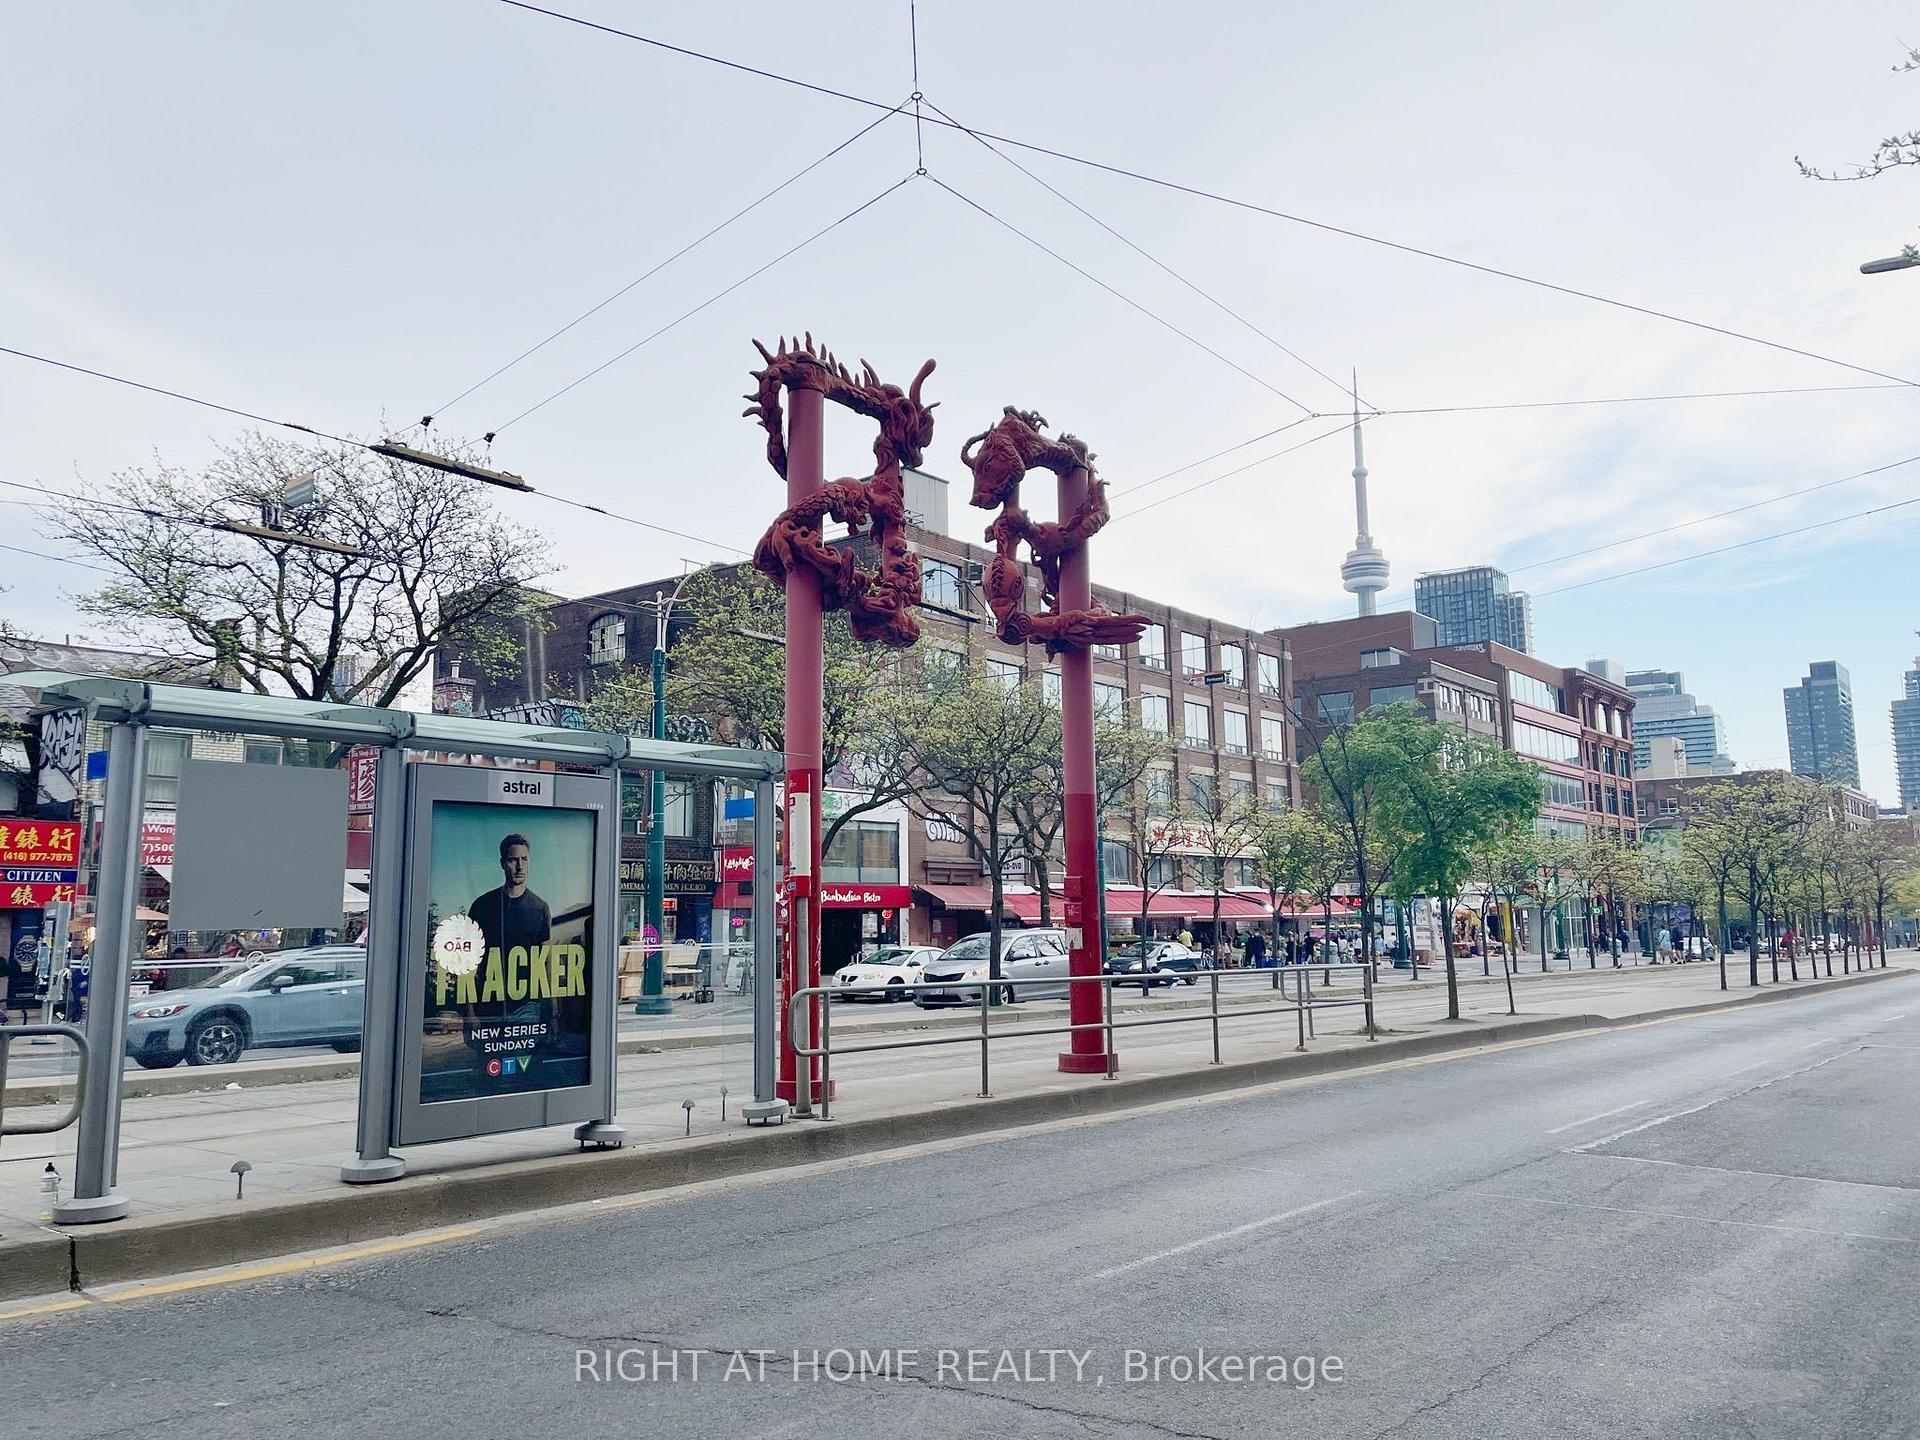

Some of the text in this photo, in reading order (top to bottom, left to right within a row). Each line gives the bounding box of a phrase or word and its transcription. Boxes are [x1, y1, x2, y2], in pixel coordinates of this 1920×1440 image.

[503, 781, 541, 795] astral
[7, 870, 62, 882] CITIZEN
[471, 1023, 548, 1041] NEW SERIES
[484, 1038, 536, 1053] SUNDAYS
[487, 1056, 532, 1076] CTV
